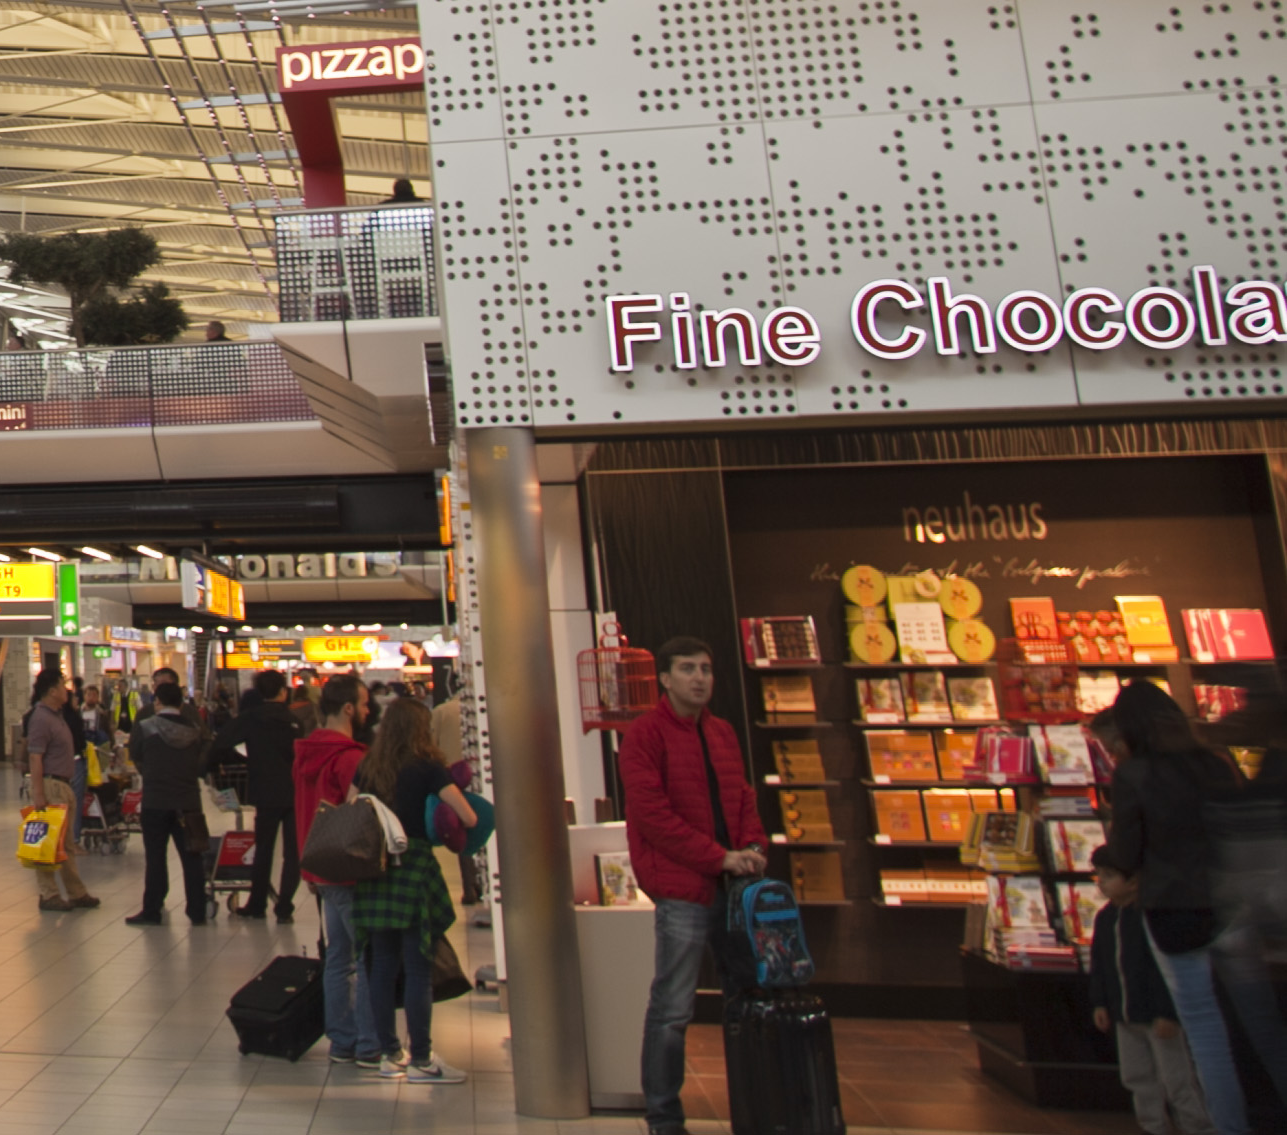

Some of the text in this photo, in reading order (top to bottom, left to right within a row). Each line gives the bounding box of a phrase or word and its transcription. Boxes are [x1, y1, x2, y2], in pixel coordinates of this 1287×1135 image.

[281, 43, 425, 88] pizzap
[605, 292, 822, 372] Fine
[901, 490, 1047, 543] neuhaus
